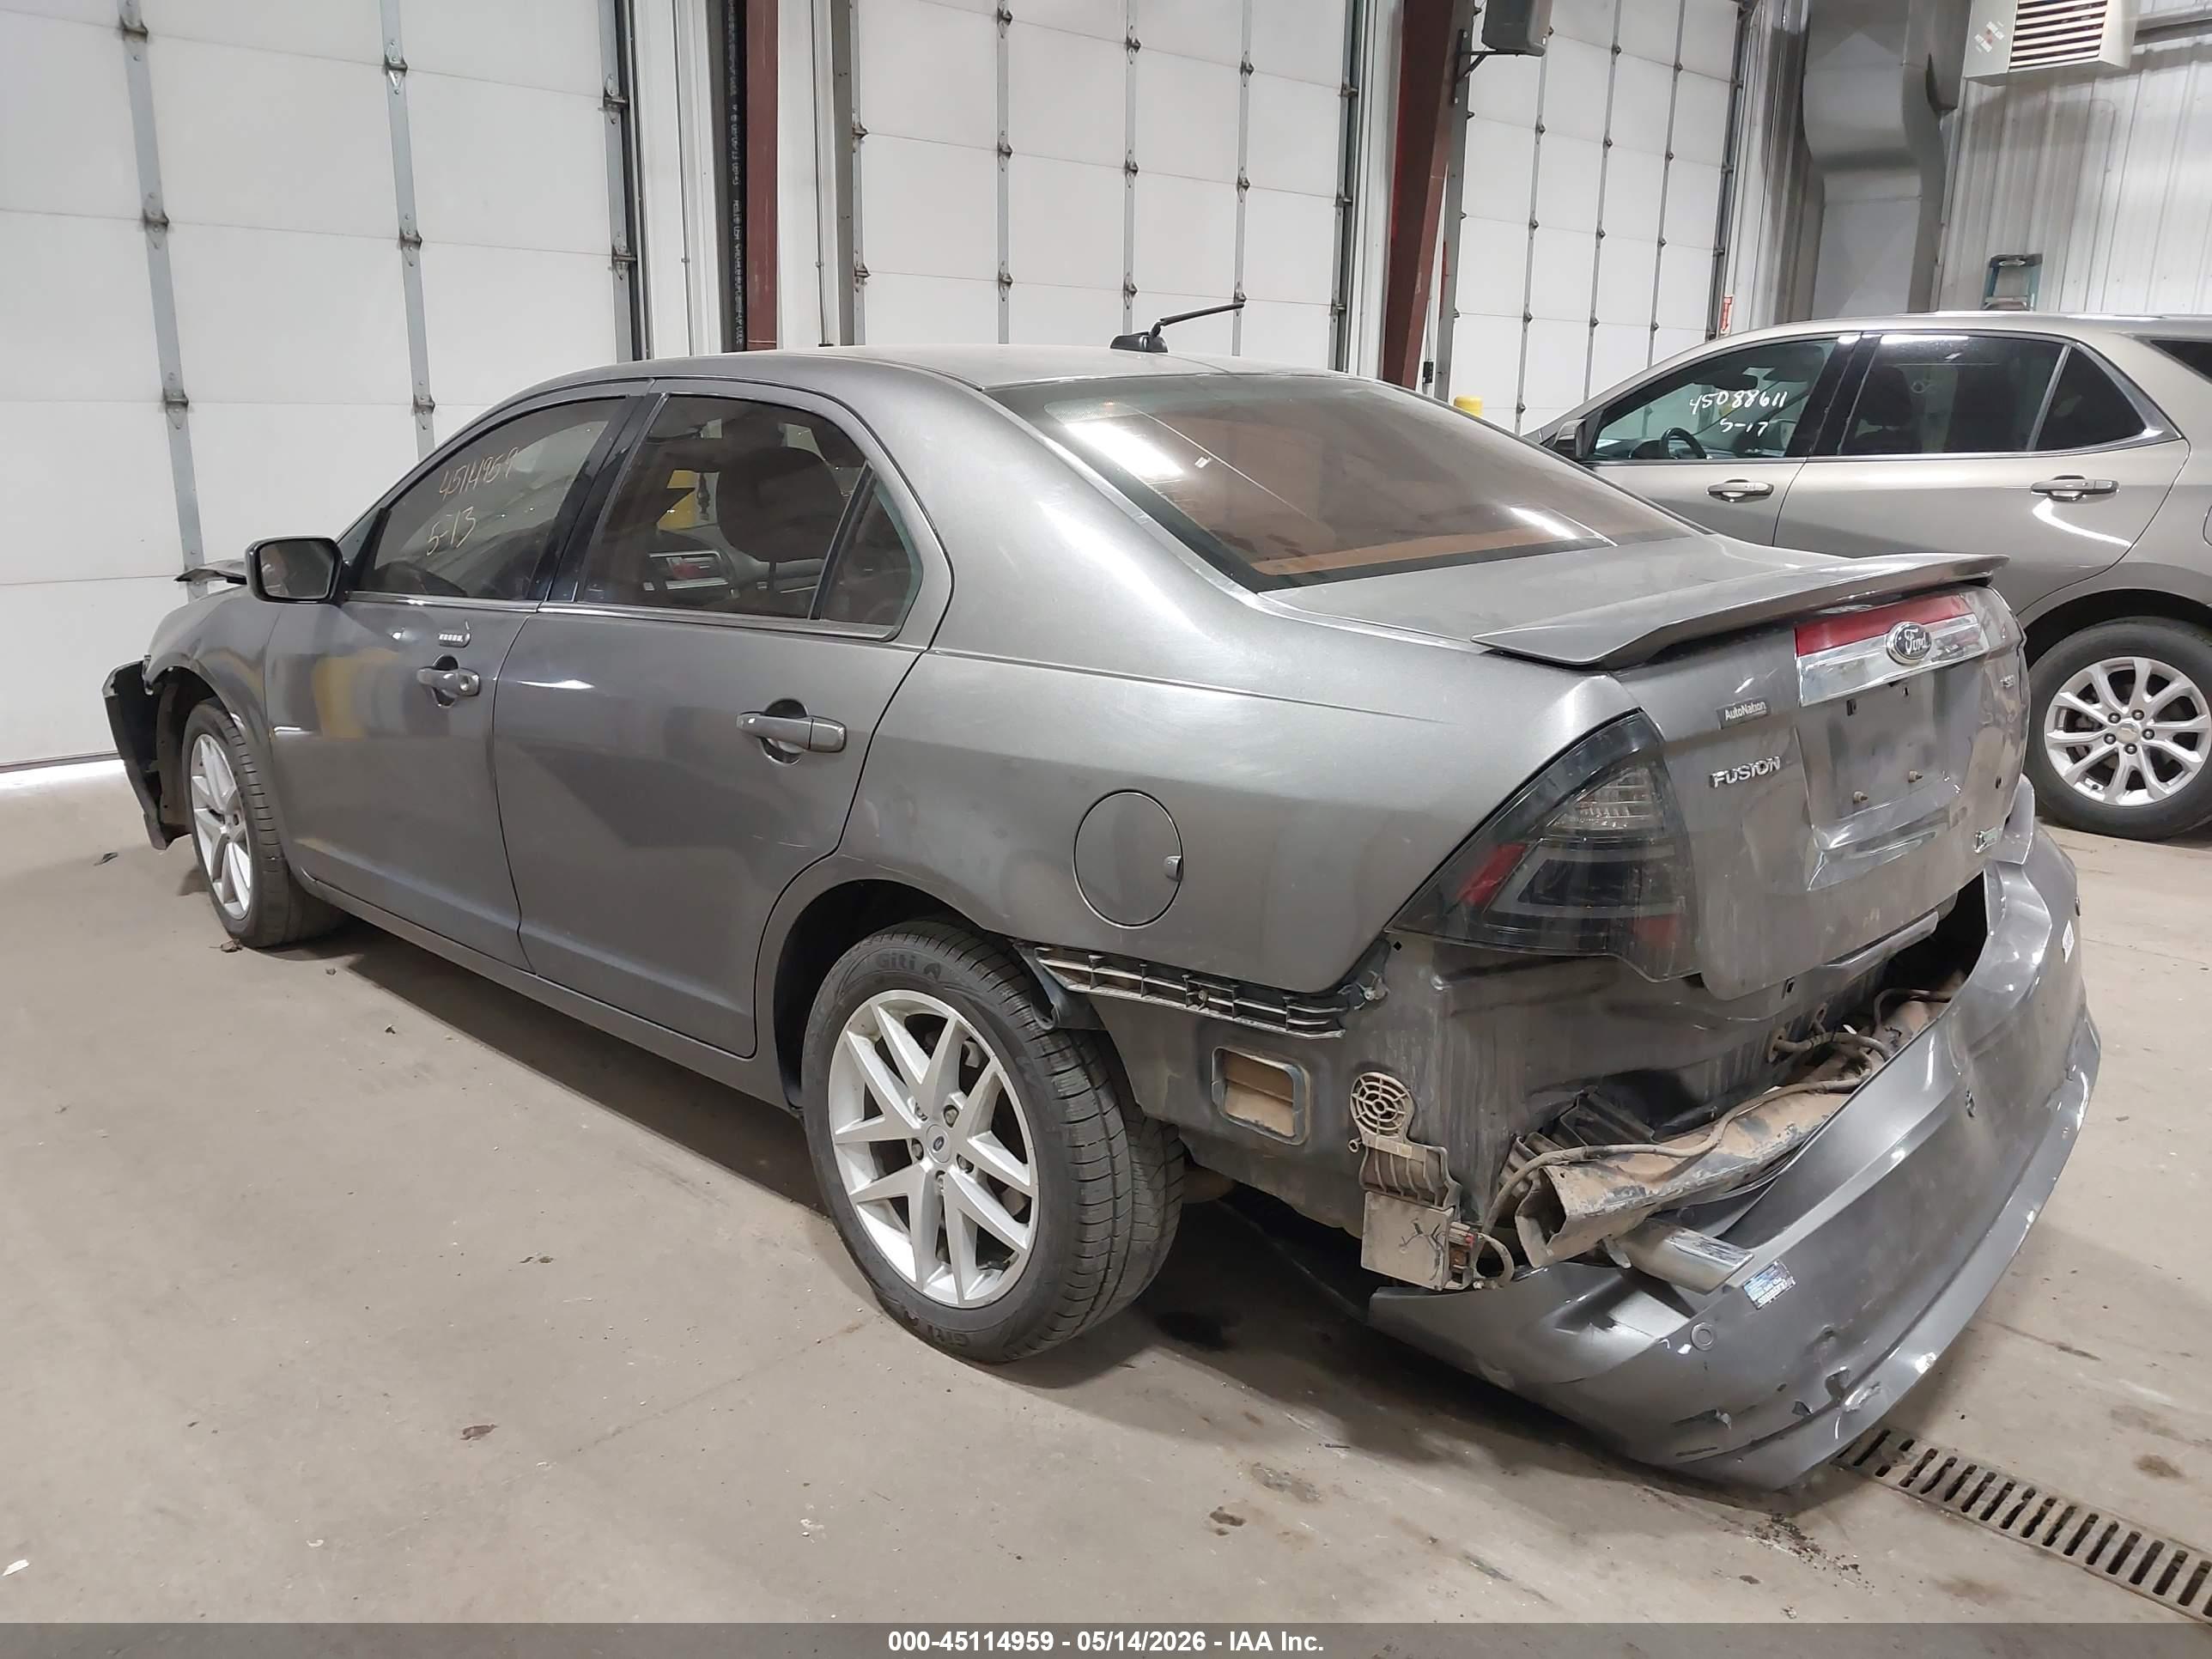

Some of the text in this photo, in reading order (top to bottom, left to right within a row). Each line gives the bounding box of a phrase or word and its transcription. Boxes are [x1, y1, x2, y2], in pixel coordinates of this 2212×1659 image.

[1689, 390, 1788, 415] 45088611
[1720, 418, 1769, 437] 5-17
[426, 506, 477, 556] 5-13
[1903, 628, 1931, 655] Ford
[1724, 701, 1767, 721] AutoNation
[1711, 756, 1781, 788] FUSION
